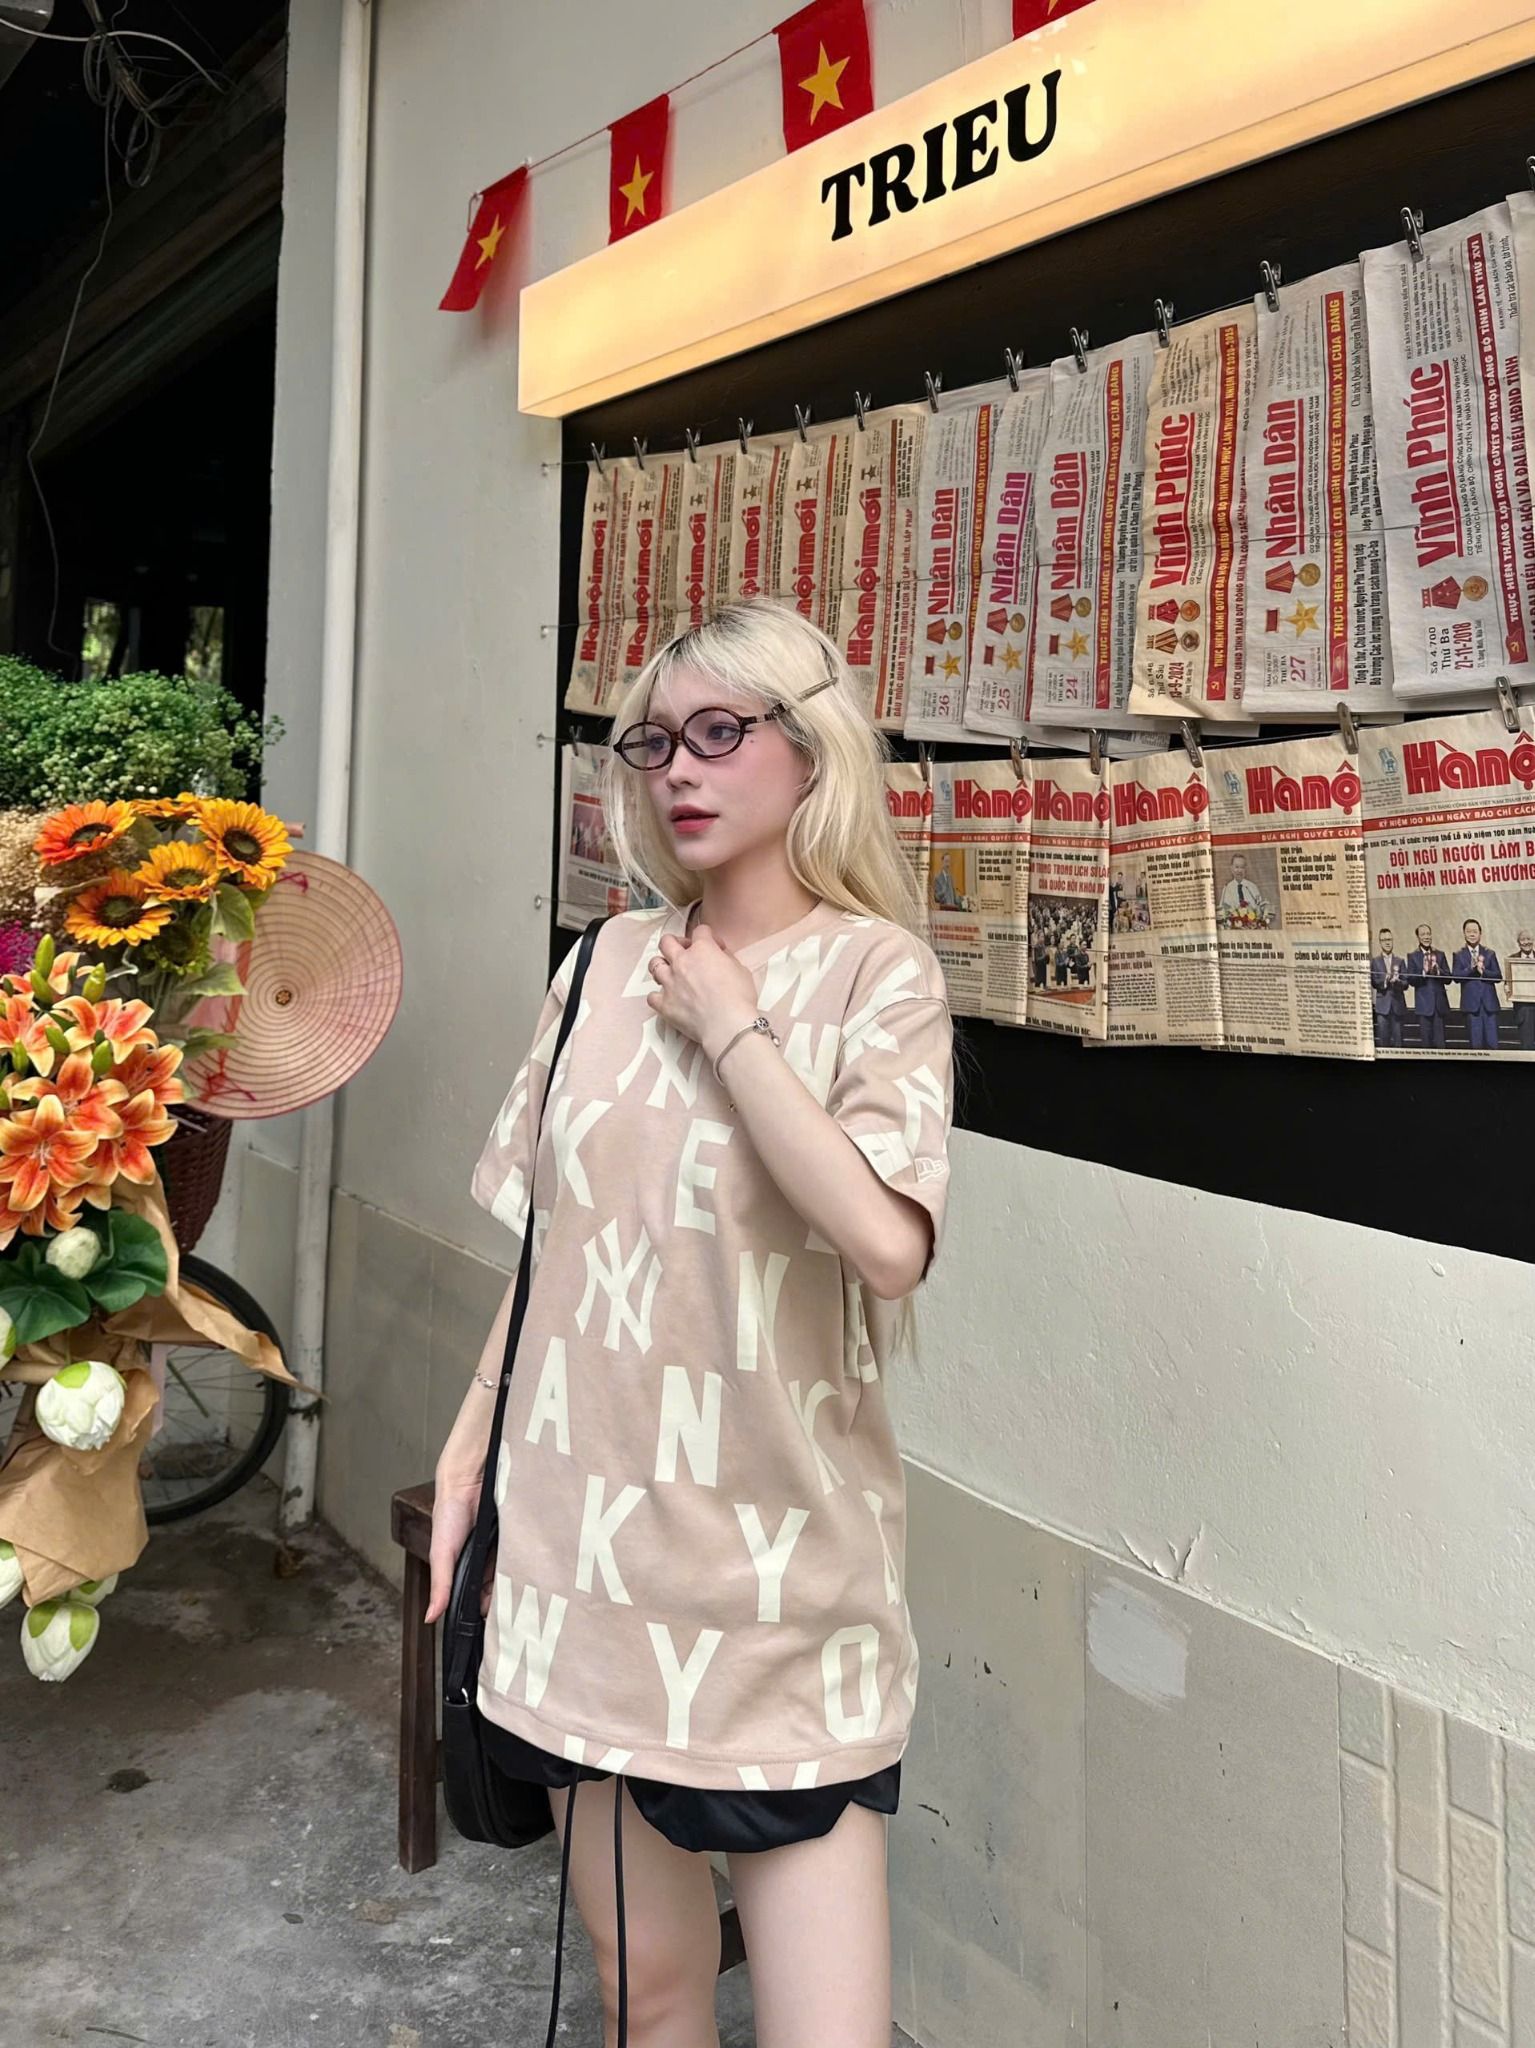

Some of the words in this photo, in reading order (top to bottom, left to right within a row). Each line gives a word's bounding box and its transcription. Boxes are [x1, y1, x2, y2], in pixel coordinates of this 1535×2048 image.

[822, 69, 1062, 242] TRIEU
[1470, 240, 1482, 259] XVI
[1472, 261, 1485, 282] THỨ
[1473, 283, 1488, 305] LẦN
[1326, 299, 1342, 332] ĐẢNG
[1476, 308, 1490, 334] TỈNH
[1328, 336, 1342, 359] CỦA
[1480, 336, 1494, 352] BỘ
[1331, 363, 1344, 380] XII
[1481, 355, 1496, 386] ĐẢNG
[1502, 356, 1520, 385] TỈNH
[1332, 384, 1345, 405] HỘI
[1486, 388, 1500, 409] HỘI
[1332, 407, 1344, 428] ĐẠI
[1403, 363, 1448, 469] Phúc
[1488, 411, 1500, 431] ĐẠI
[1264, 399, 1296, 466] Dân
[1154, 413, 1189, 505] Phúc
[1330, 432, 1343, 470] QUYẾT
[1488, 434, 1502, 466] QUYẾT
[1050, 452, 1080, 508] Dân
[1331, 474, 1344, 504] NGHỊ
[1493, 468, 1508, 498] NGHỊ
[997, 472, 1027, 524] Dân
[1498, 500, 1511, 519] LỢI
[930, 488, 954, 540] Dân
[1264, 472, 1297, 558] Nhân
[1332, 506, 1344, 526] LỢI
[1410, 471, 1456, 568] Vĩnh
[1051, 516, 1078, 590] Nhân
[1150, 512, 1186, 589] Vĩnh
[1330, 530, 1344, 570] THẮNG
[1500, 520, 1514, 560] THẮNG
[846, 488, 882, 666] Hànộimới
[927, 548, 951, 615] Nhân
[989, 532, 1018, 604] Nhân
[1504, 563, 1518, 590] HIỆN
[1333, 574, 1345, 602] HIỆN
[1332, 606, 1345, 638] THỰC
[1508, 592, 1520, 622] THỰC
[1428, 626, 1438, 658] 4.700
[1440, 628, 1450, 644] Ba
[1452, 622, 1474, 670] 27-11-2018
[1155, 664, 1165, 680] Sáu
[1290, 656, 1306, 682] 27
[1440, 648, 1452, 669] Thứ
[998, 688, 1010, 710] 25
[1065, 678, 1078, 700] 24
[1156, 681, 1166, 696] Thứ
[938, 694, 950, 716] 26
[1390, 850, 1409, 870] ĐỘI
[1414, 844, 1438, 864] NGŨ
[1442, 841, 1485, 863] NGƯỜI
[1490, 840, 1520, 860] LÀM
[1377, 870, 1400, 890] ĐÓN
[1404, 866, 1436, 890] NHẬN
[1440, 865, 1476, 886] HUÂN
[552, 1096, 615, 1209] K
[674, 1118, 735, 1236] E
[524, 1335, 572, 1456] A
[655, 1365, 722, 1488] N
[576, 1473, 649, 1606] K
[733, 1503, 811, 1623] Y
[495, 1571, 569, 1710] W
[646, 1621, 724, 1750] Y
